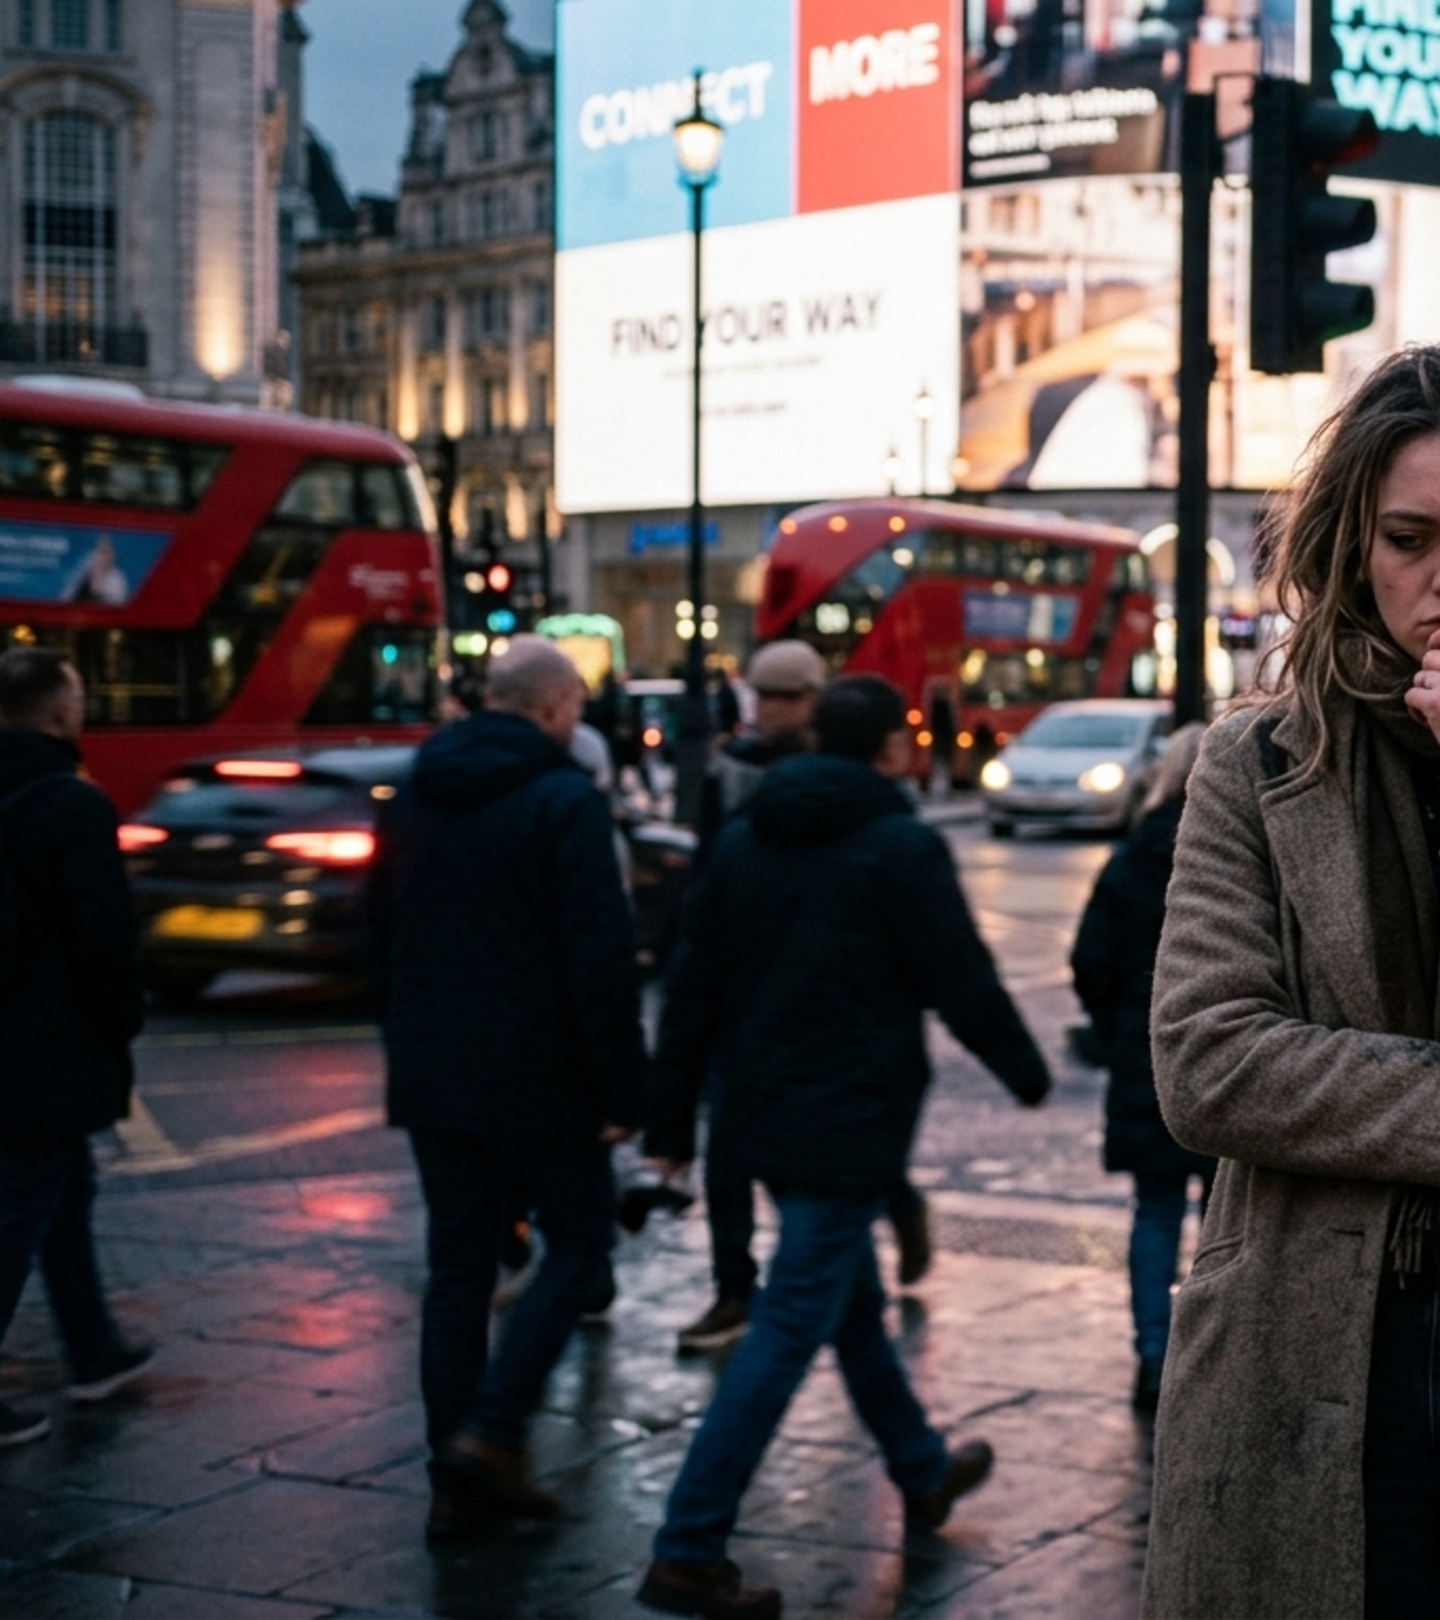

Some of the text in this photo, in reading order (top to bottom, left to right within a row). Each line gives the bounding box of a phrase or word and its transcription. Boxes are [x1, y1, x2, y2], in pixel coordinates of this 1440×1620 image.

[810, 23, 940, 104] MORE
[613, 314, 681, 354] FIND
[805, 293, 881, 335] WAY
